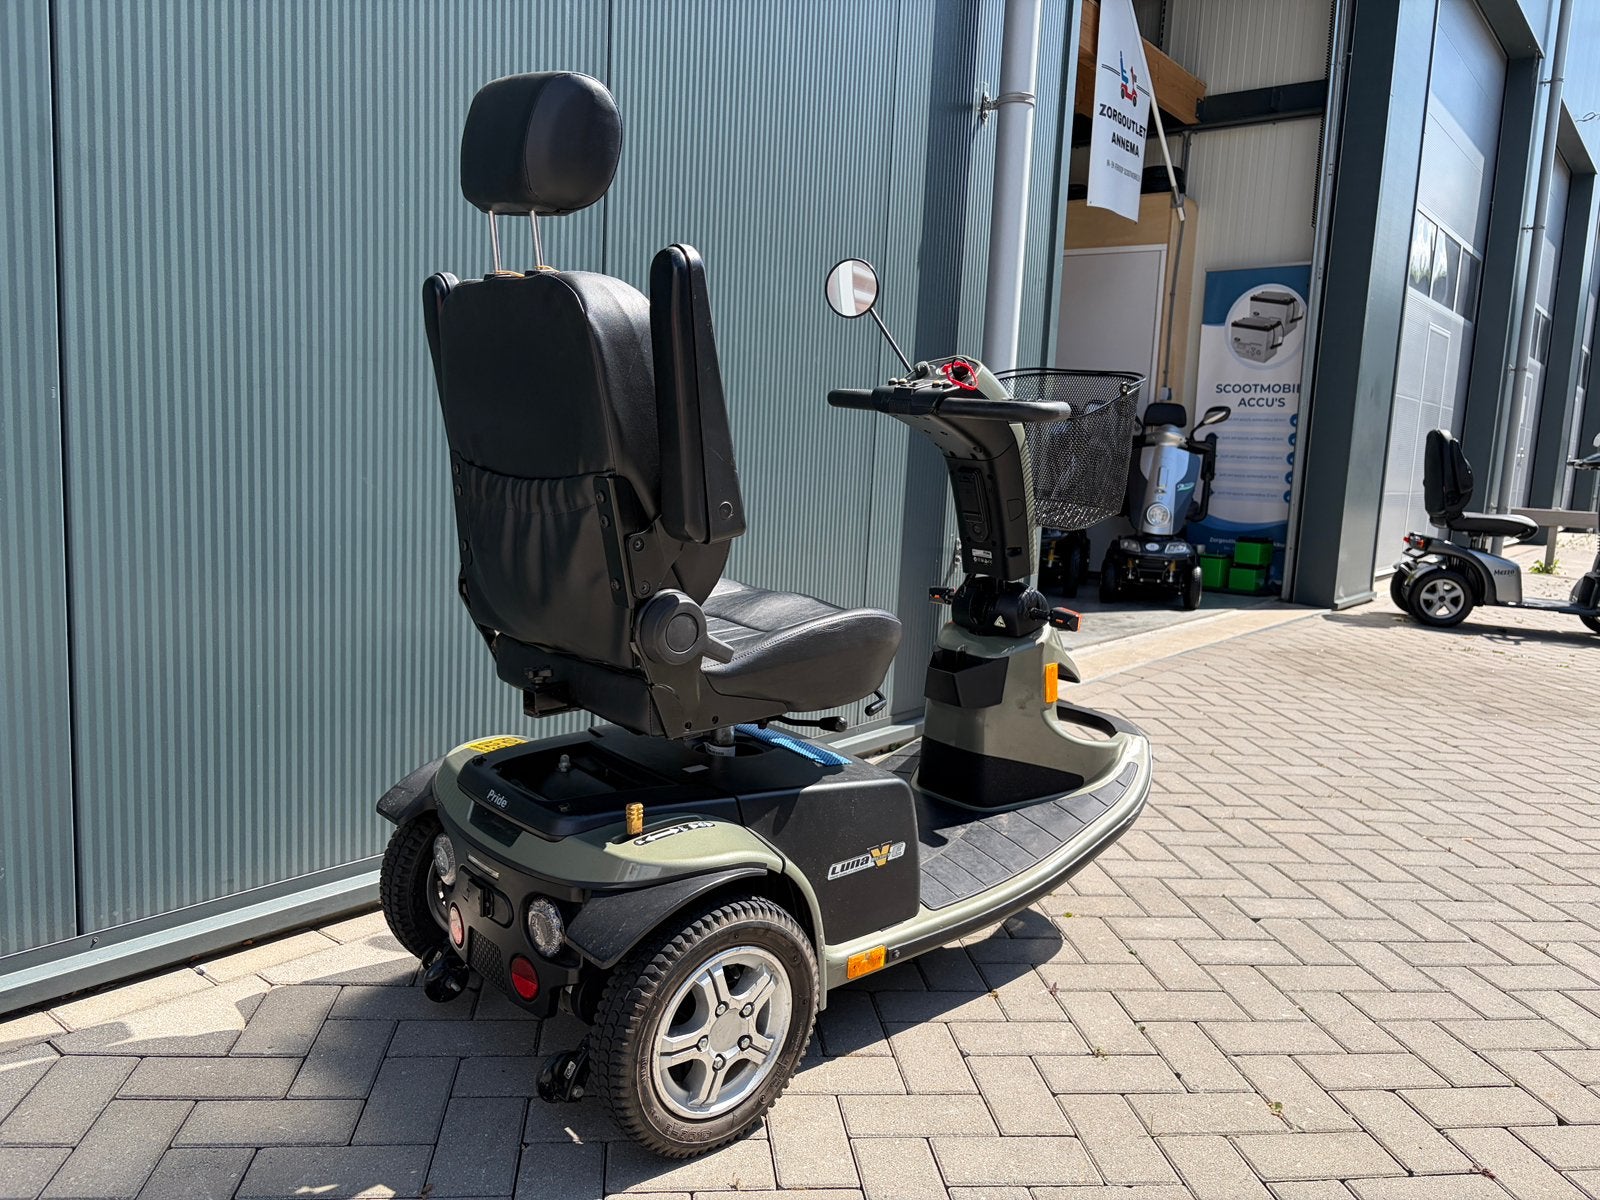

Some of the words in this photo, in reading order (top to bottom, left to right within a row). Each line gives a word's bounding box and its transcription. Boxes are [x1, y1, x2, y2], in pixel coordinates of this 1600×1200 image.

[1099, 104, 1147, 138] ZORGOUTLET
[1111, 132, 1140, 158] ANNEMA
[1237, 397, 1286, 408] ACCU'S
[486, 789, 508, 808] Pride
